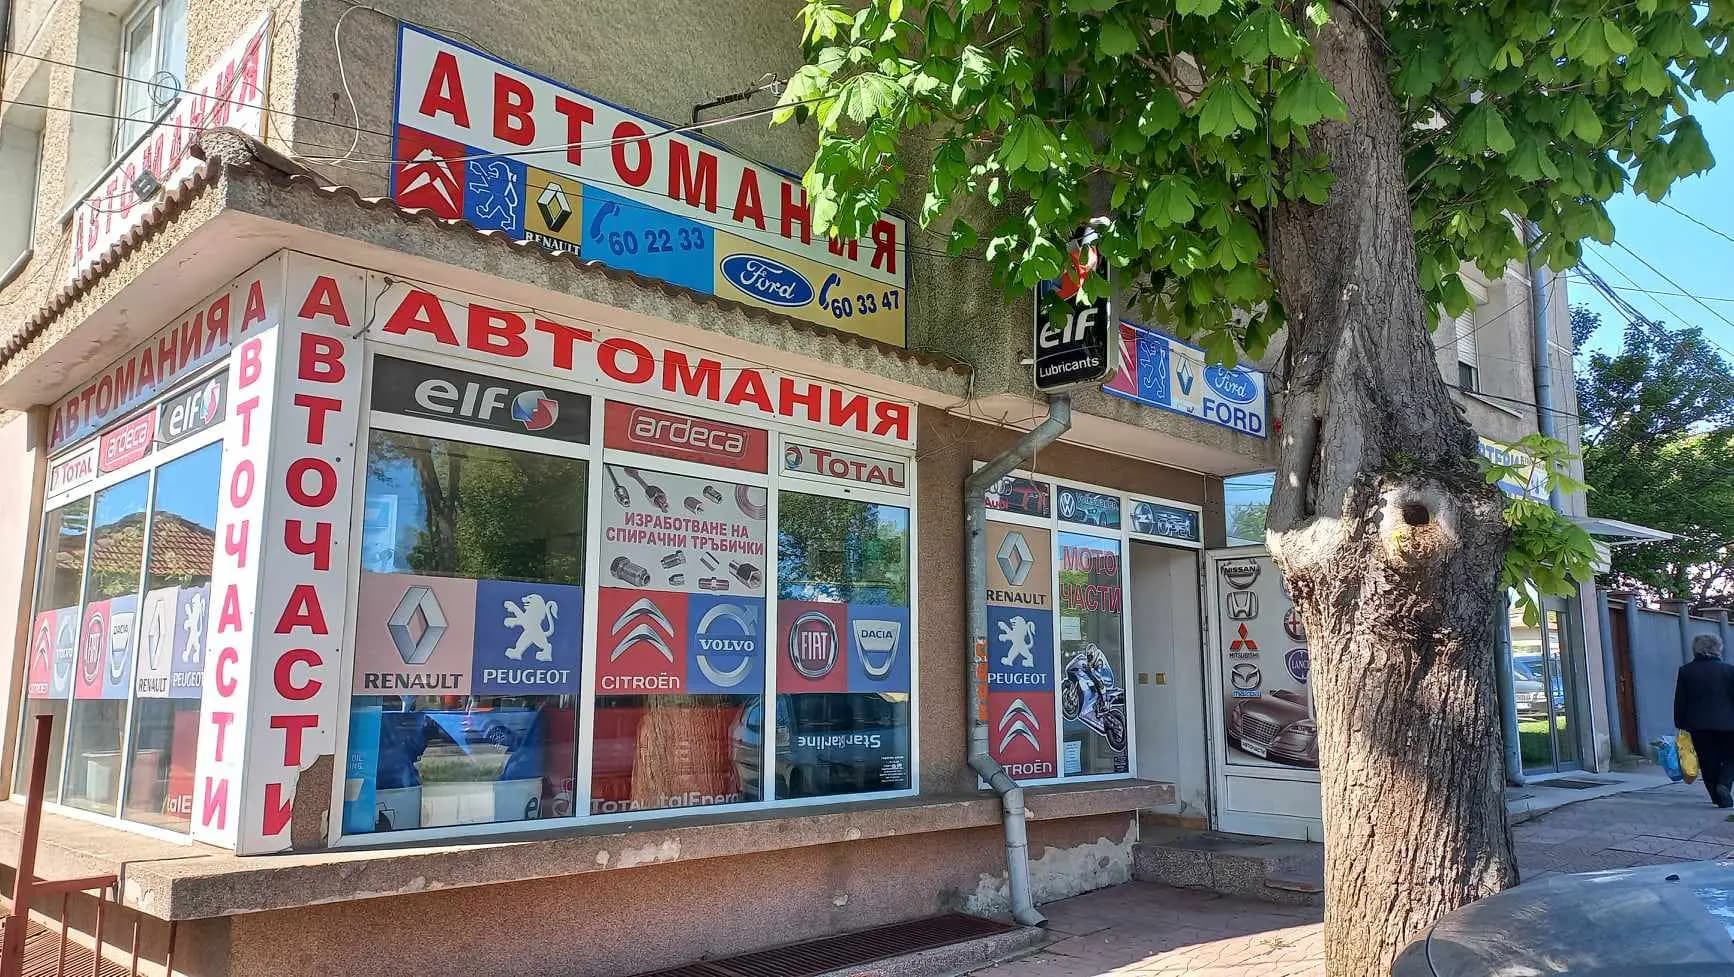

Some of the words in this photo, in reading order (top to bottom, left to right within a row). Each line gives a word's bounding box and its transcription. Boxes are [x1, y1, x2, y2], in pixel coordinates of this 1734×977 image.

[608, 230, 639, 256] 60
[644, 228, 674, 253] 22
[678, 226, 705, 250] 33
[740, 253, 796, 301] Ford
[831, 297, 853, 319] 60
[856, 293, 877, 315] 33
[881, 290, 899, 311] 47
[1039, 307, 1099, 349] elf
[50, 292, 232, 449] АВТОМАНИЯ
[383, 289, 909, 441] АВТОМАНИЯ
[1039, 356, 1100, 378] Lubricants
[413, 378, 509, 417] elf
[1214, 367, 1248, 398] Ford
[168, 391, 201, 436] elf
[1202, 397, 1263, 434] FORD
[106, 420, 149, 459] ardeca
[635, 413, 745, 454] ardeca
[809, 448, 905, 489] TOTAL
[624, 511, 728, 536] ИЗРАБОТВАНЕ
[731, 523, 749, 539] НА
[201, 279, 268, 832] АВТОЧАСТИ
[606, 526, 687, 548] СПИРАЧНИ
[690, 535, 764, 556] ТРЪБИЧКИ
[1063, 545, 1118, 576] МОТО
[1224, 565, 1256, 574] NISSAN
[986, 589, 1047, 606] RENAULT
[1060, 583, 1121, 614] ЧАСТИ
[700, 638, 755, 653] VOLVO
[801, 629, 829, 658] FIAT
[861, 629, 893, 641] DACIA
[138, 677, 168, 693] RENAULT
[364, 672, 463, 690] RENAULT
[483, 668, 571, 686] PEUGEOT
[987, 672, 1048, 685] PEUGEOT
[1002, 759, 1053, 776] TROËN
